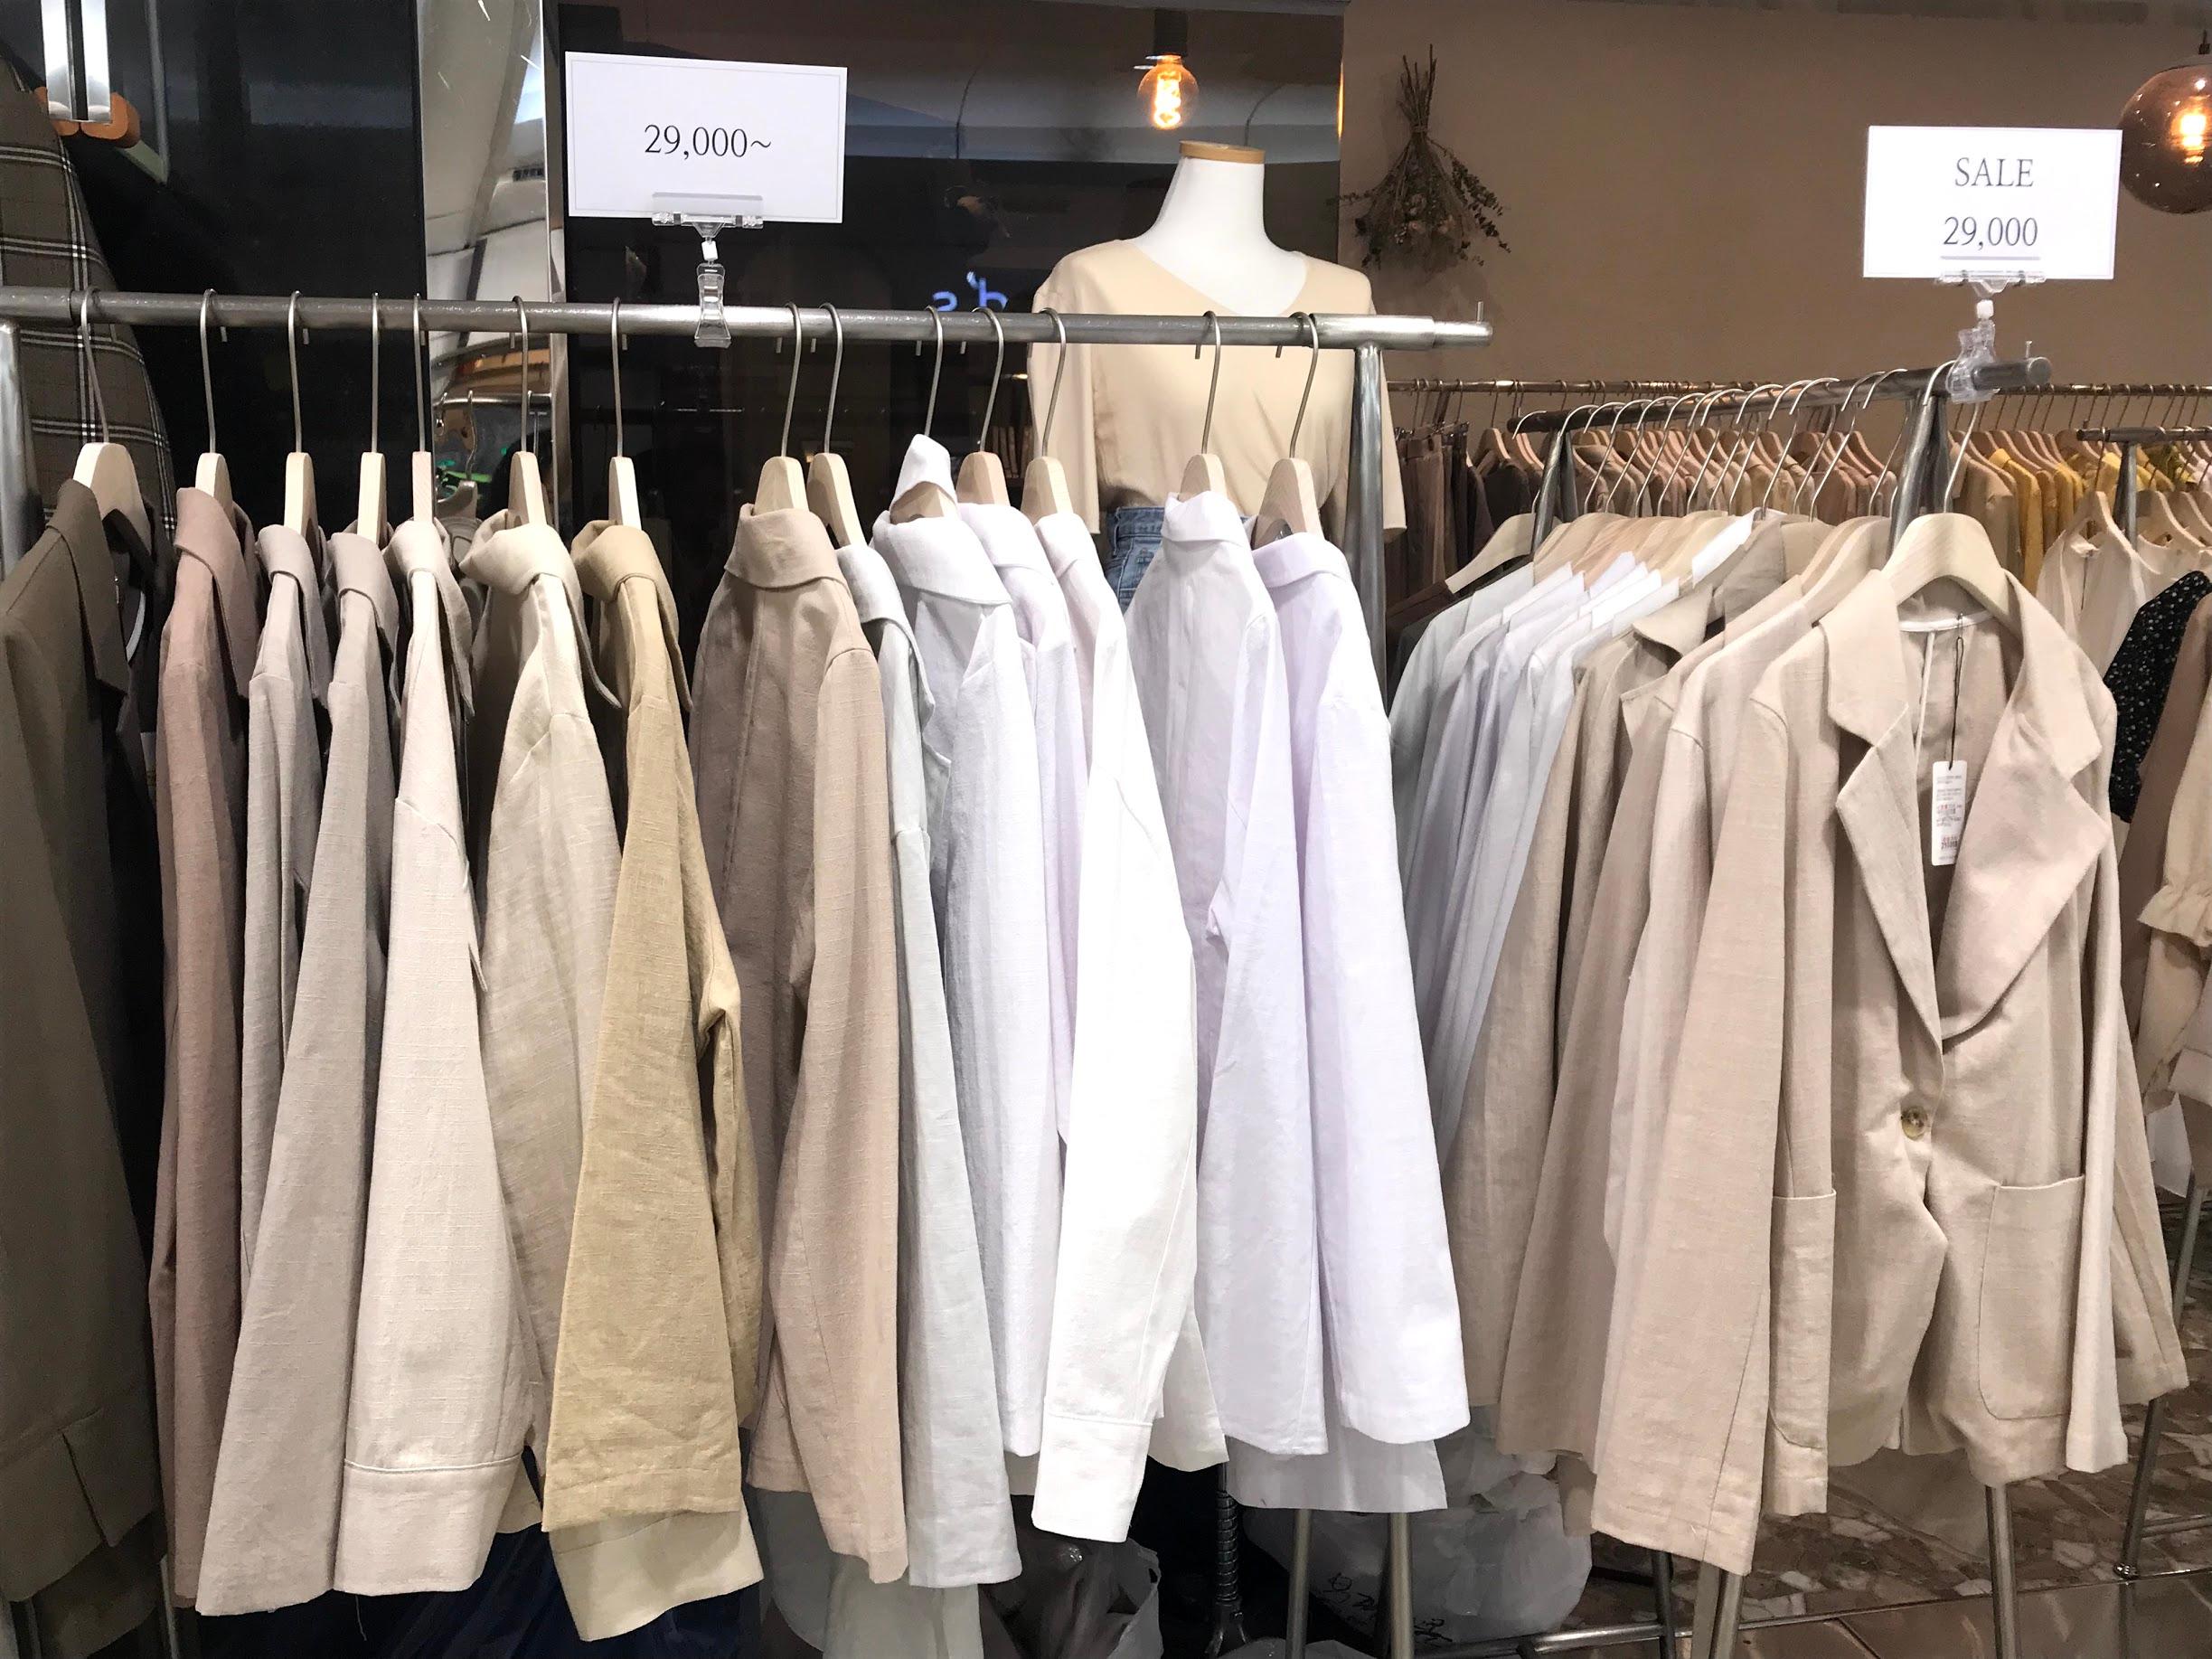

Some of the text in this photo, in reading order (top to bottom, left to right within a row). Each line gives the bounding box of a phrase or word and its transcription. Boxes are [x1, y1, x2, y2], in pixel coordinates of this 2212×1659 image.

[645, 125, 771, 160] 29,000~
[1954, 157, 2033, 187] SALE
[1944, 217, 2038, 250] 29,000
